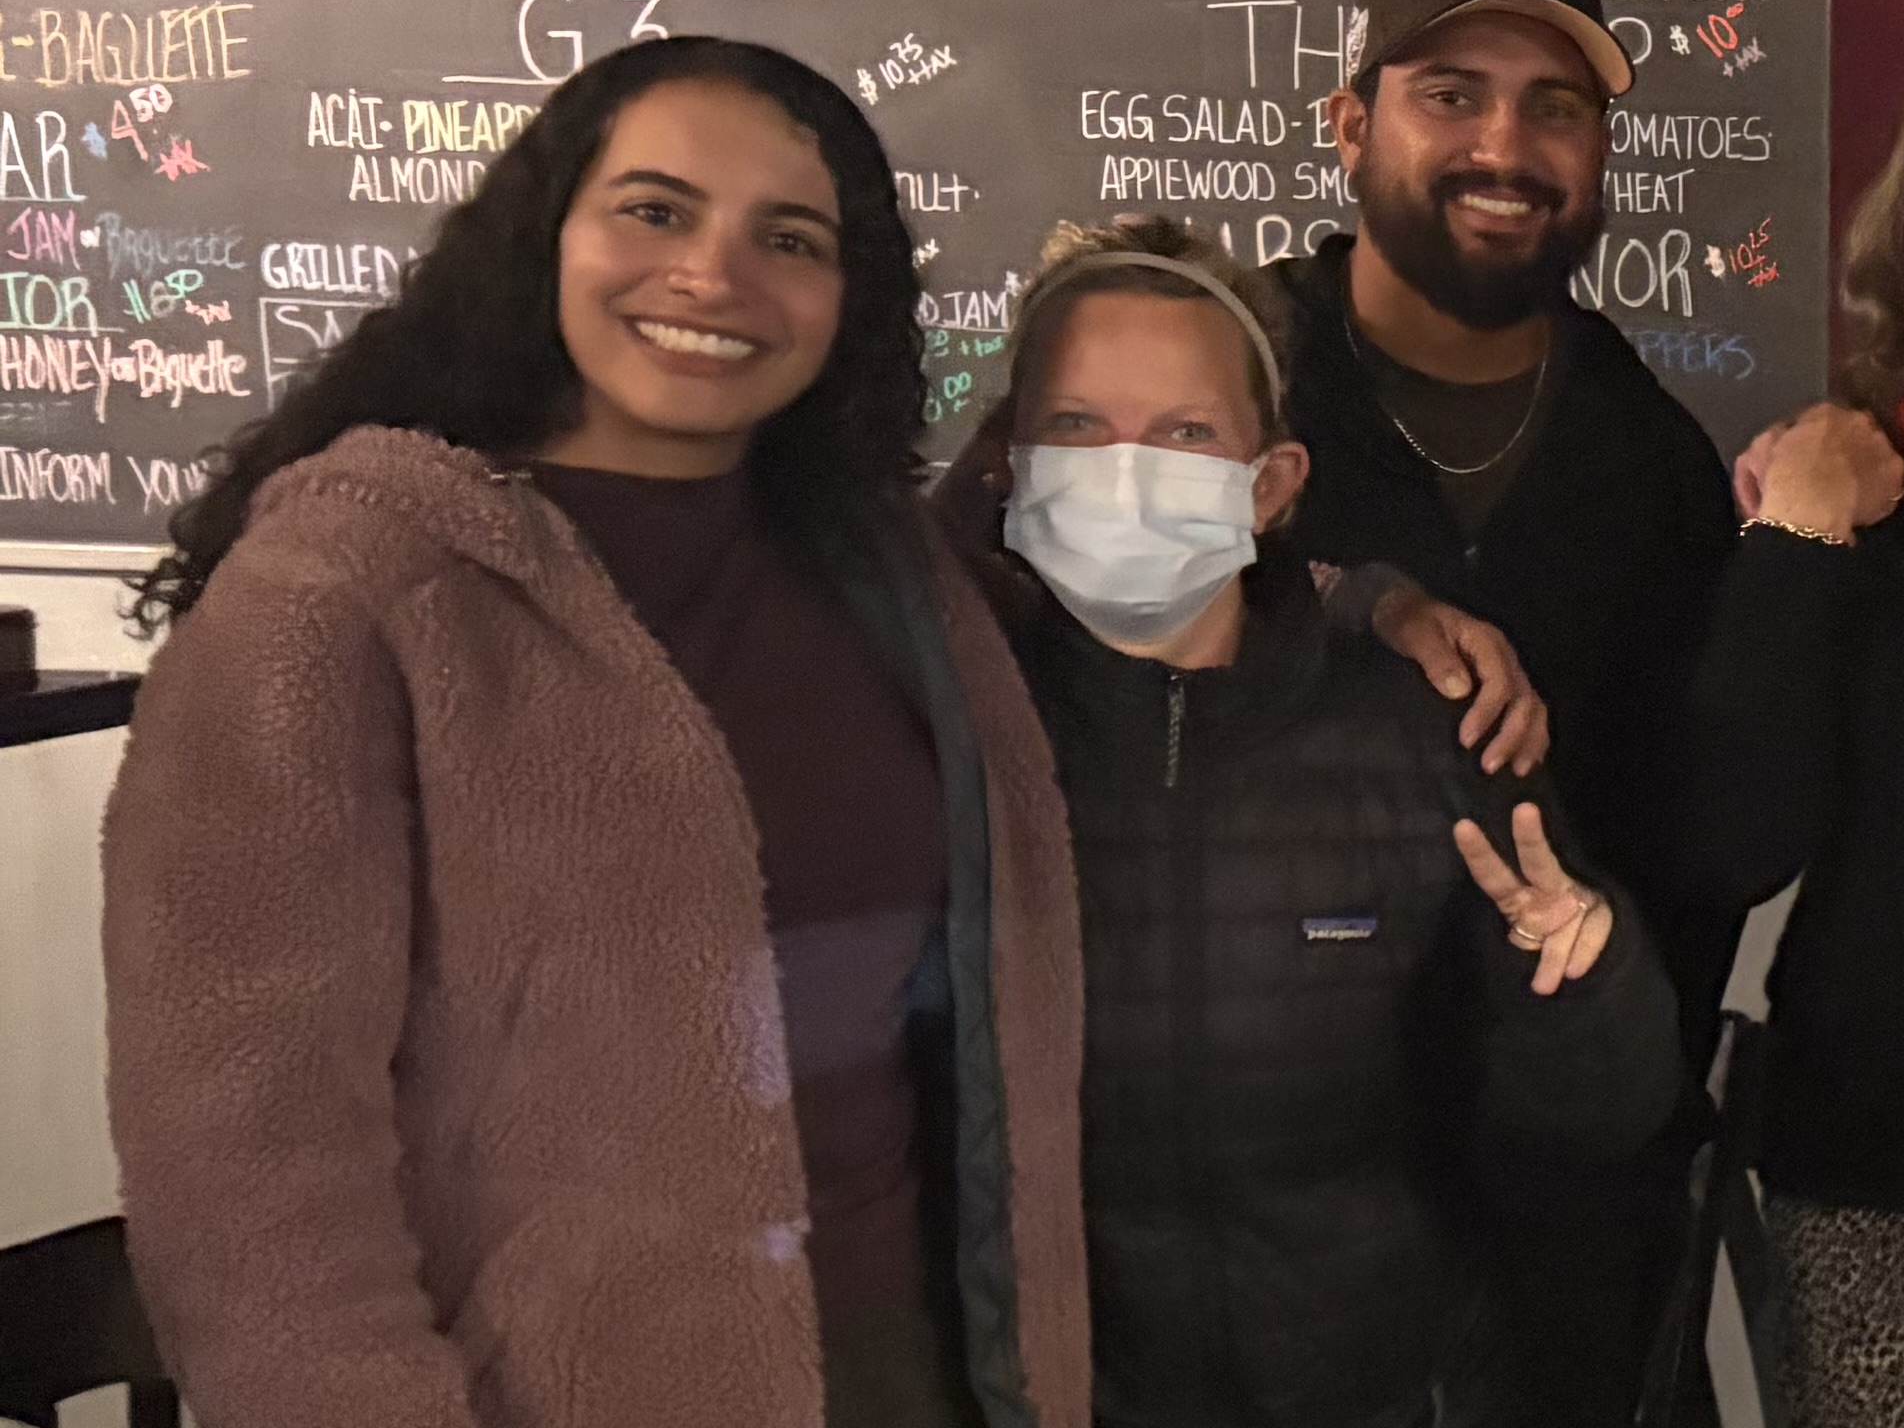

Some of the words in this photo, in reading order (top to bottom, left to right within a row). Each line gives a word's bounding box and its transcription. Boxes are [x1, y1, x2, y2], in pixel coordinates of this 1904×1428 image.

[1081, 89, 1155, 143] EGG
[1162, 93, 1286, 147] SALAD
[1606, 96, 1771, 161] OMATOES
[1603, 168, 1695, 214] HEAT
[7, 207, 81, 271] JAM
[943, 289, 1011, 328] JAM
